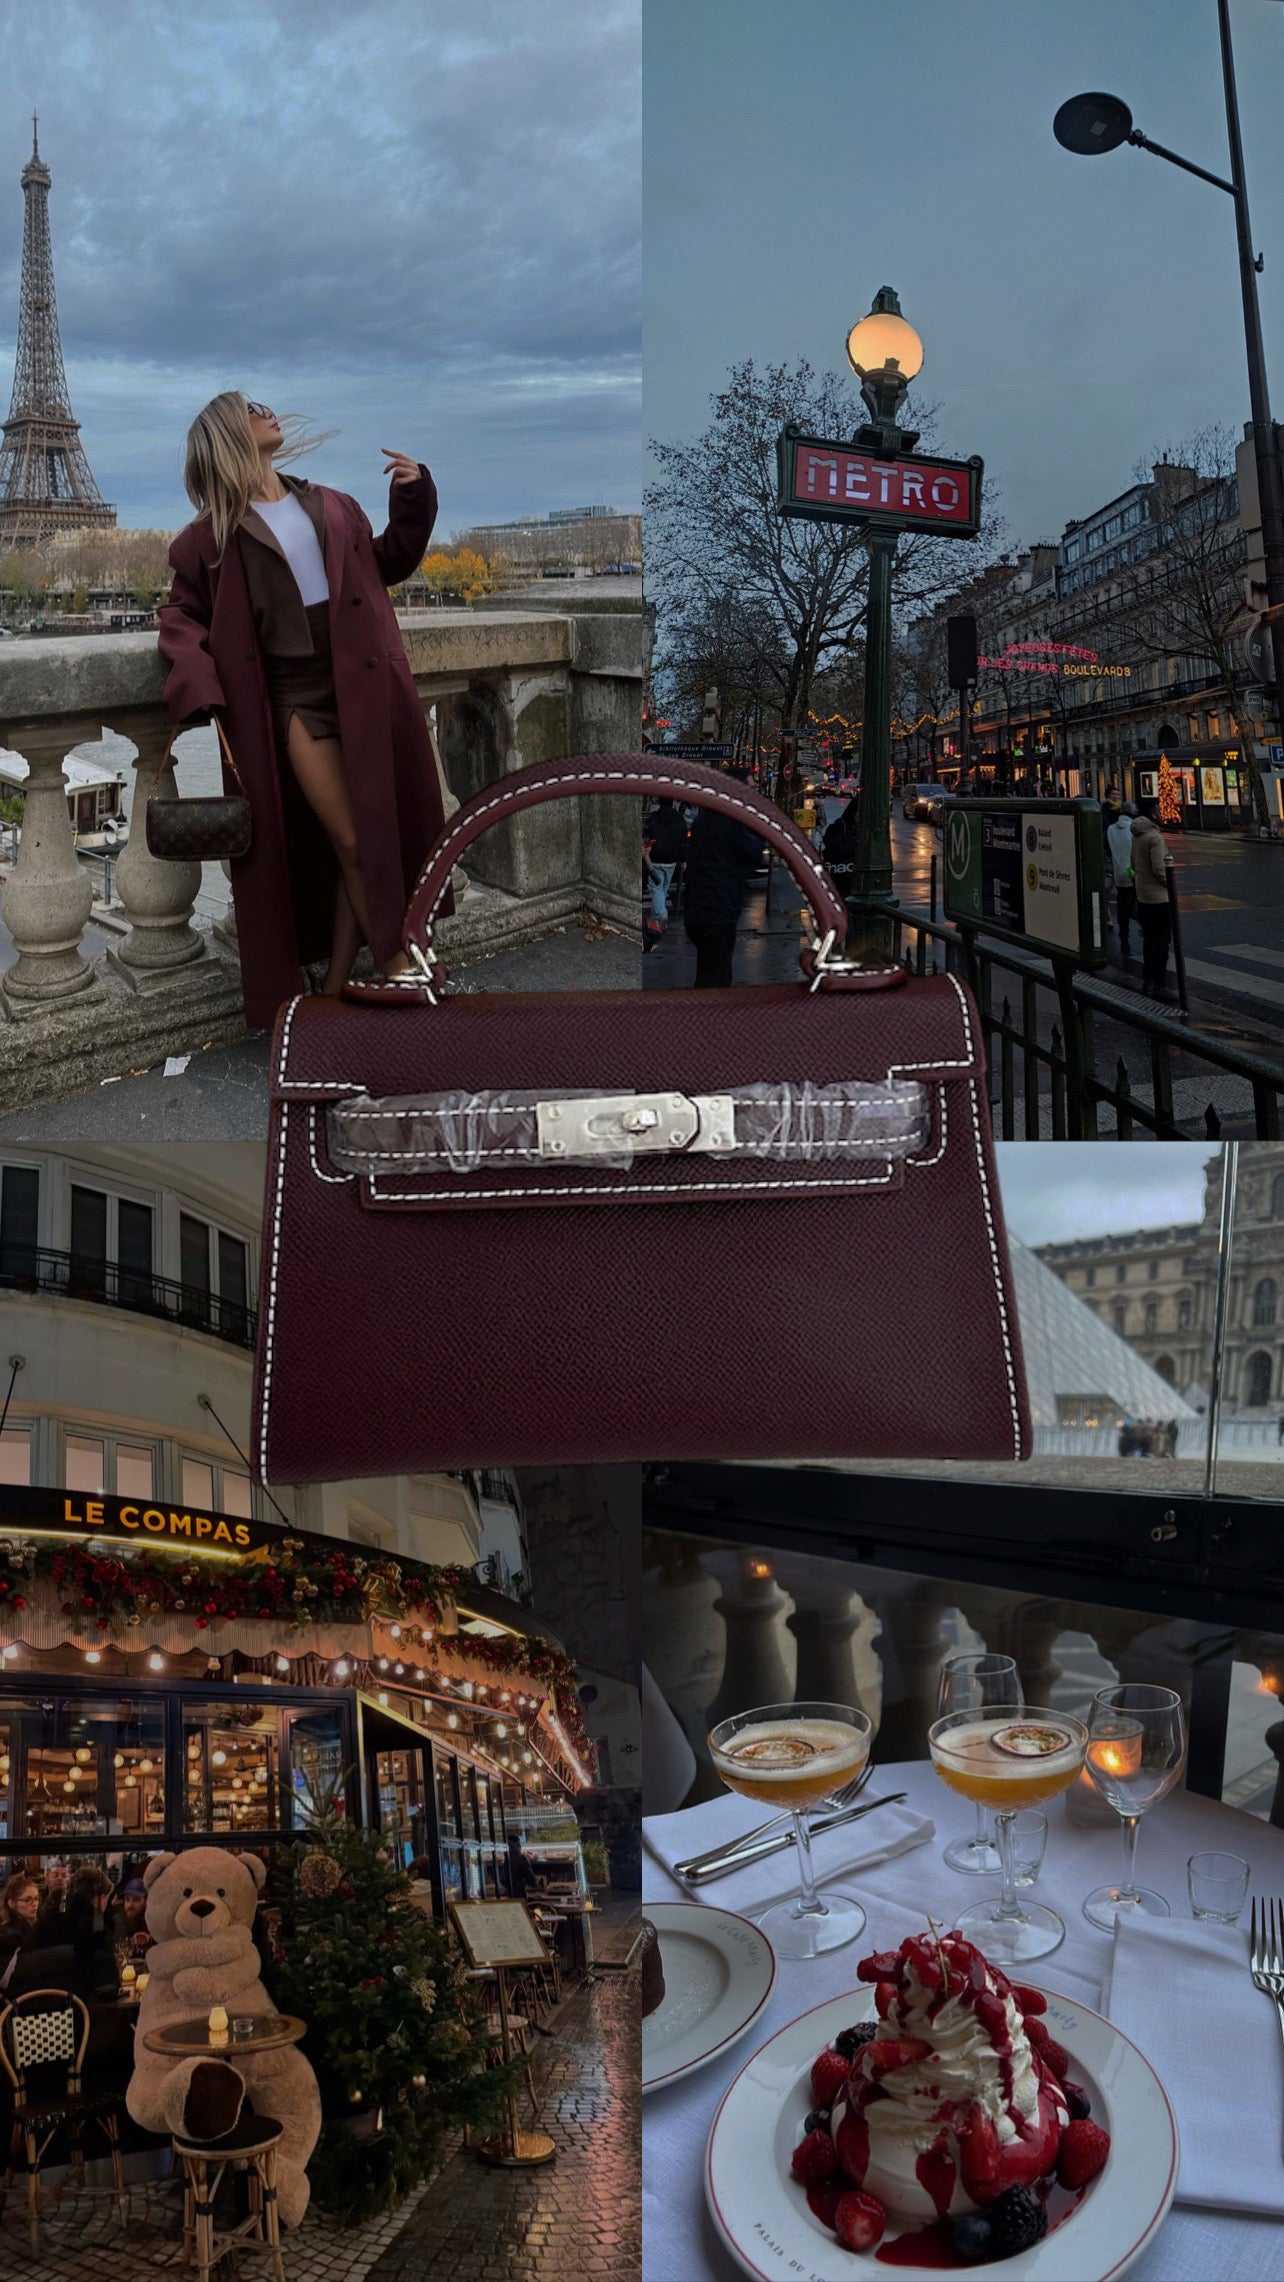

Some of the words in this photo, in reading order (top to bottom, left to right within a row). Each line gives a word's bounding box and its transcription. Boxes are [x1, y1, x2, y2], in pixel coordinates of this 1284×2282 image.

[807, 455, 959, 511] METRO
[1004, 642, 1062, 655] JOYEUSES
[990, 657, 1013, 670] LES
[1063, 664, 1132, 677] BOULEVARDS
[1029, 869, 1035, 885] 9
[64, 1499, 105, 1525] LE
[119, 1506, 251, 1546] COMPAS
[754, 2222, 784, 2257] PALAIS
[789, 2259, 805, 2272] DU
